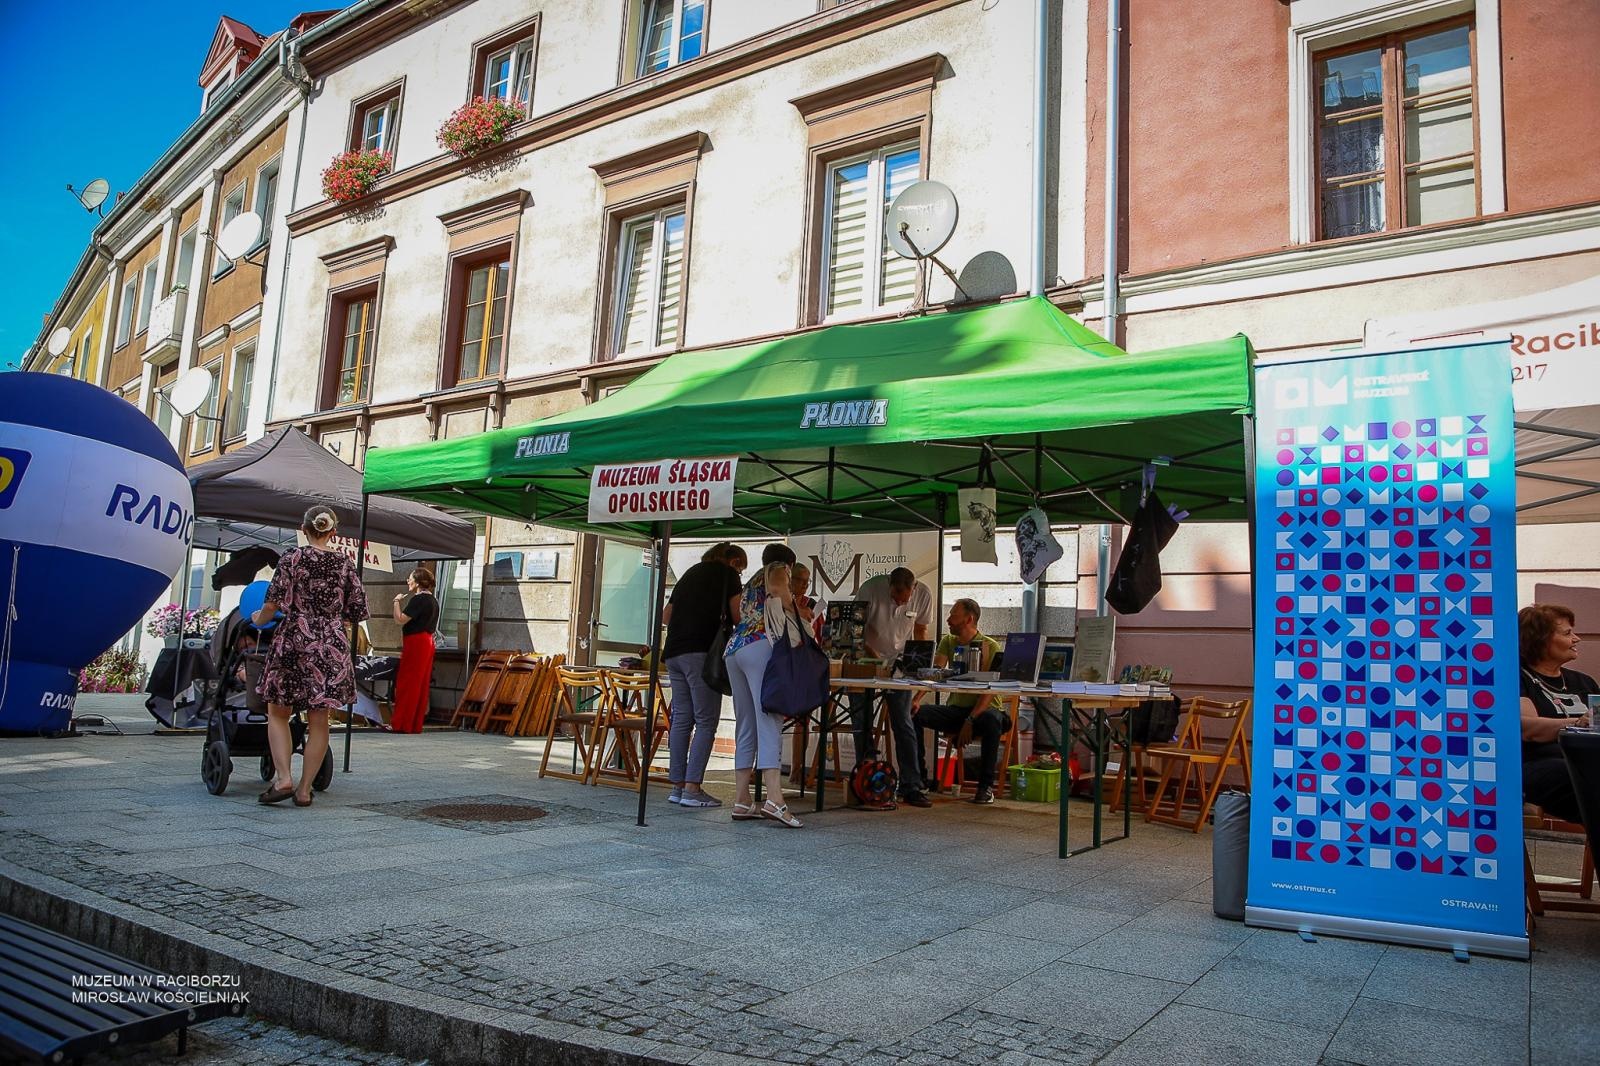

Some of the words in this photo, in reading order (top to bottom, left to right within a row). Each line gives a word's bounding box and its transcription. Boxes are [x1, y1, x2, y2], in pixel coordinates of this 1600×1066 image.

[800, 399, 888, 429] PŁONIA
[514, 432, 571, 458] PŁONIA
[597, 465, 661, 488] MUZEUM
[668, 459, 731, 487] ŚLĄSKA
[608, 488, 710, 514] OPOLSKIEGO
[330, 535, 369, 551] UZEUM
[866, 553, 907, 564] Muzeum
[1441, 899, 1498, 912] OSTRAVA!!!
